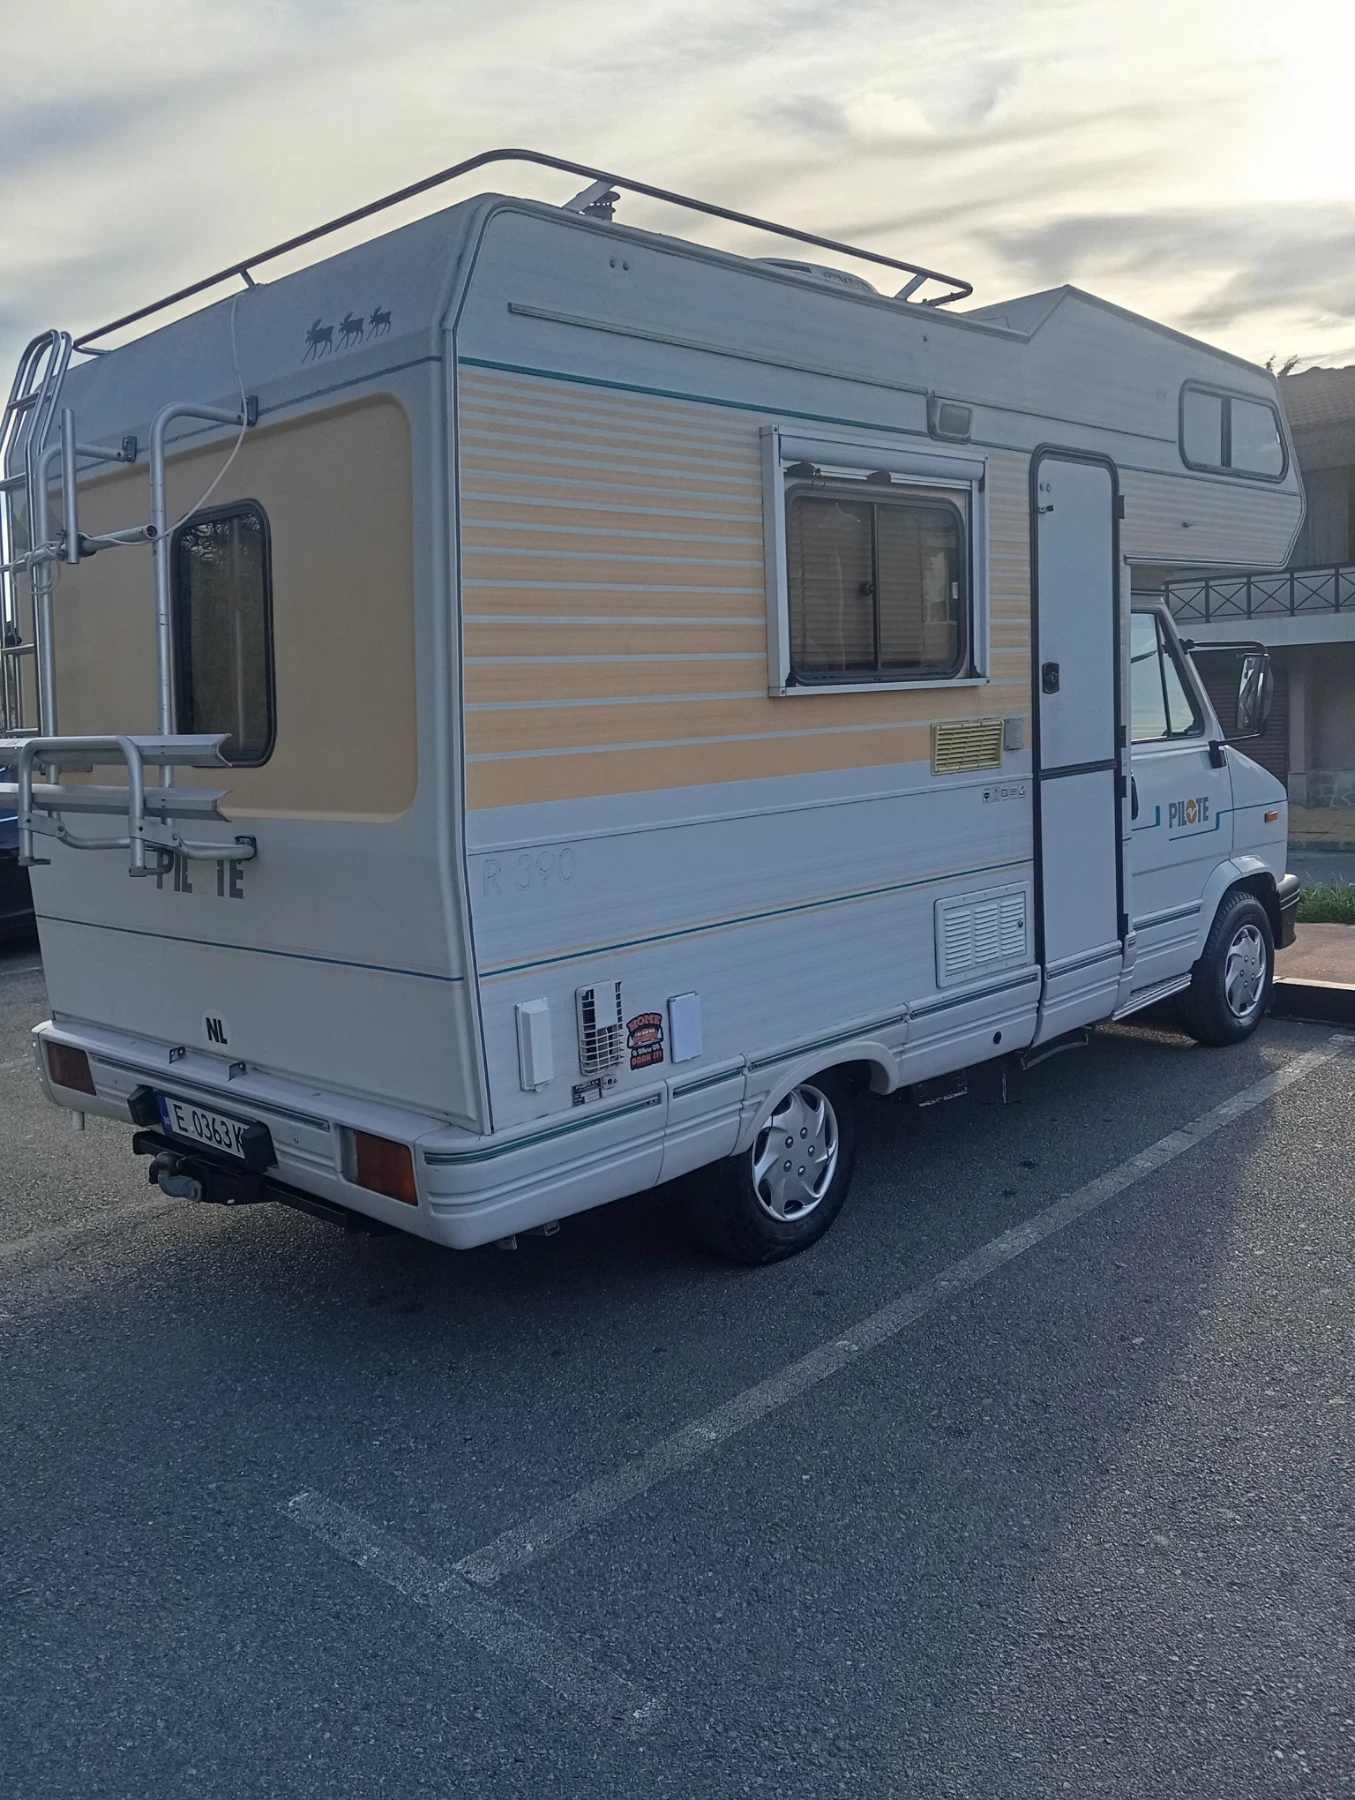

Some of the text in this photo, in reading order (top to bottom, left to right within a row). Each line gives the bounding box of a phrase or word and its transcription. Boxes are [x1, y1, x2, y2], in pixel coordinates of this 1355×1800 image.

[1168, 796, 1209, 829] PILOTE
[483, 847, 577, 897] R 390
[205, 1016, 228, 1045] NL
[628, 1013, 662, 1031] HOME
[173, 1103, 188, 1133] E
